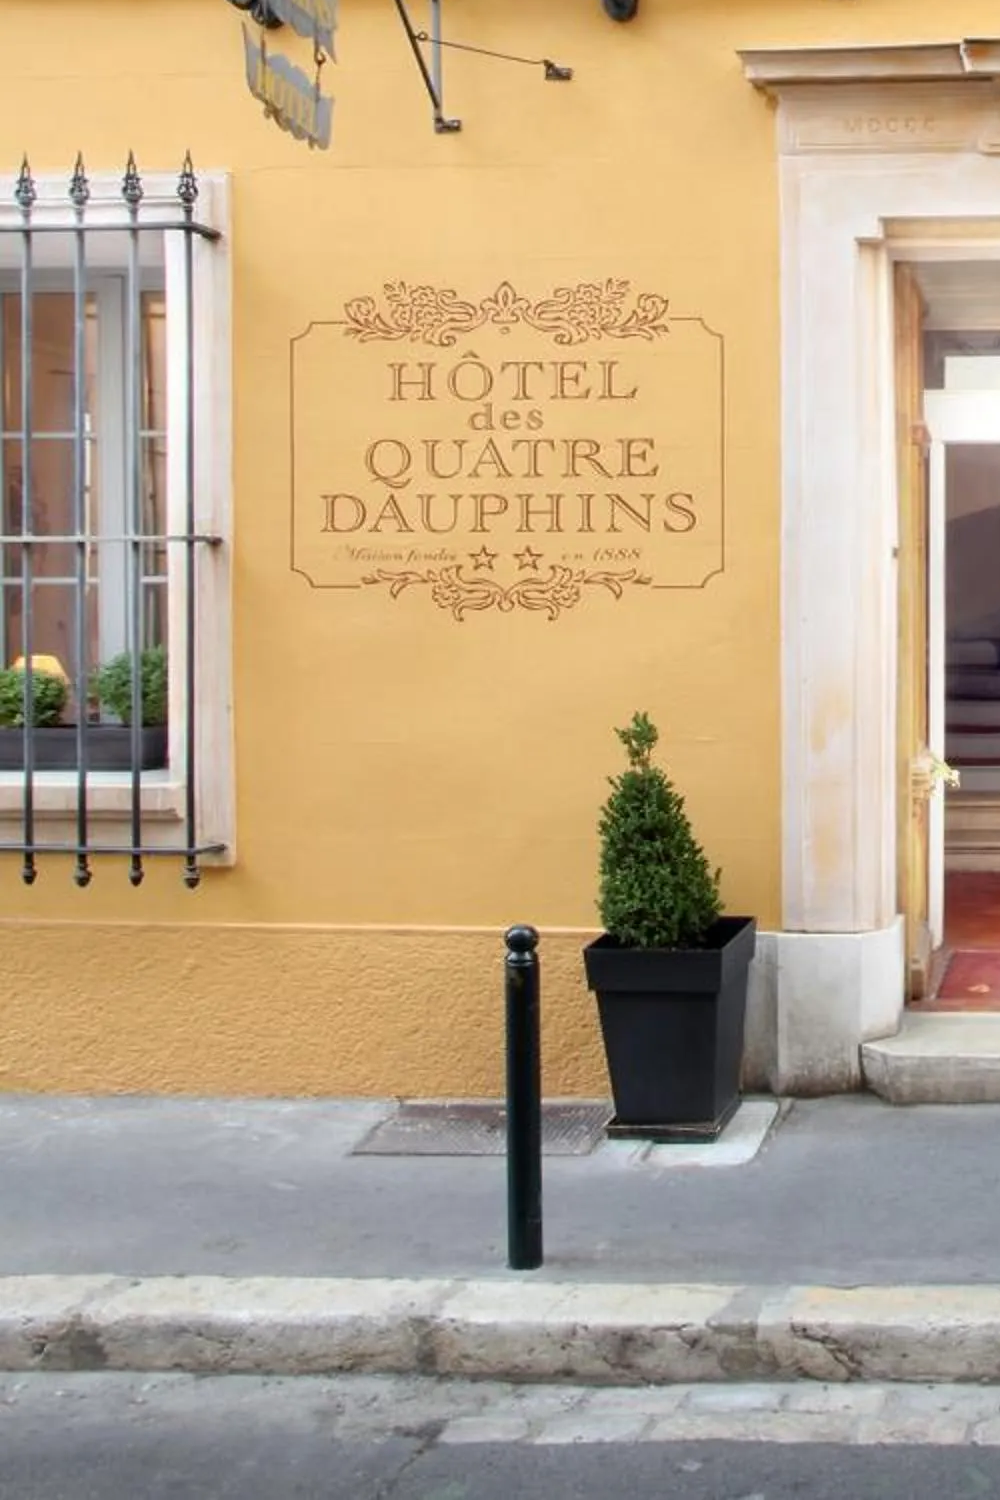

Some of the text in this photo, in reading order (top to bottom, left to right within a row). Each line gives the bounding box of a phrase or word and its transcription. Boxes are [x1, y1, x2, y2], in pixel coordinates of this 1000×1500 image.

[387, 350, 639, 401] HÔTEL
[467, 402, 545, 431] des
[363, 437, 660, 489] QUATRE
[319, 493, 698, 533] DAUPHINS
[593, 547, 642, 561] 1888
[967, 983, 990, 994] 4
